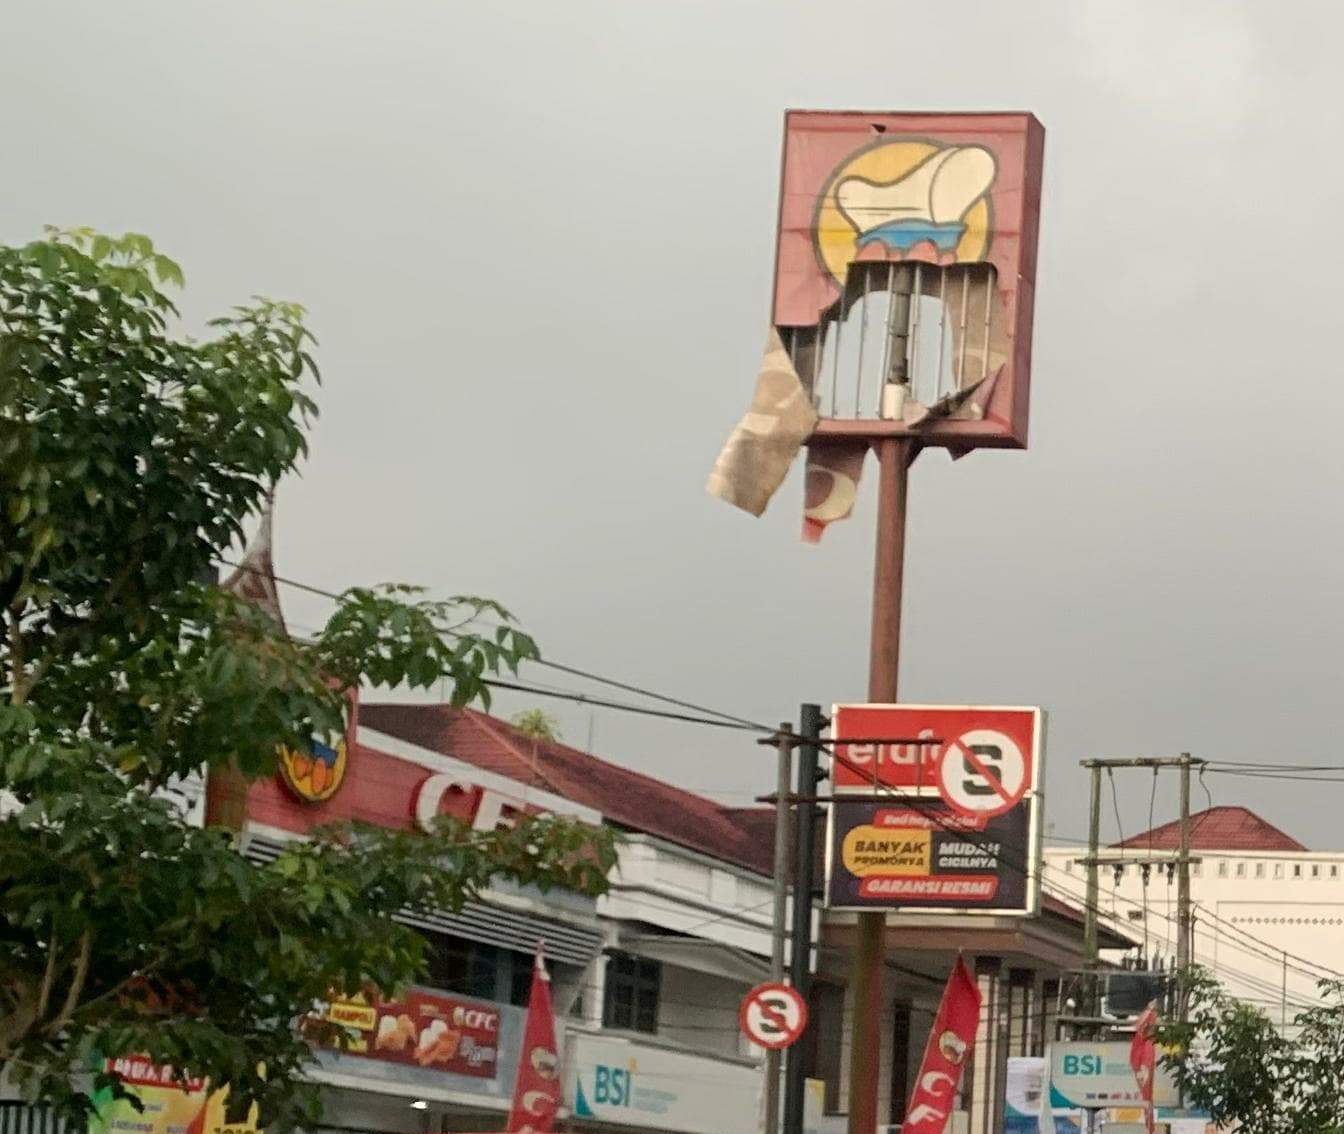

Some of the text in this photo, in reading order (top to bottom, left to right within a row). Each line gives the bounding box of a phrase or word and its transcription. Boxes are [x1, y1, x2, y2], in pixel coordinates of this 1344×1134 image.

[416, 773, 556, 835] CF
[854, 840, 927, 853] BANYAK
[938, 857, 998, 868] CICILNYA
[867, 879, 993, 895] GARANSI RESMI
[1063, 1054, 1102, 1076] BSI
[594, 1065, 631, 1107] BSI
